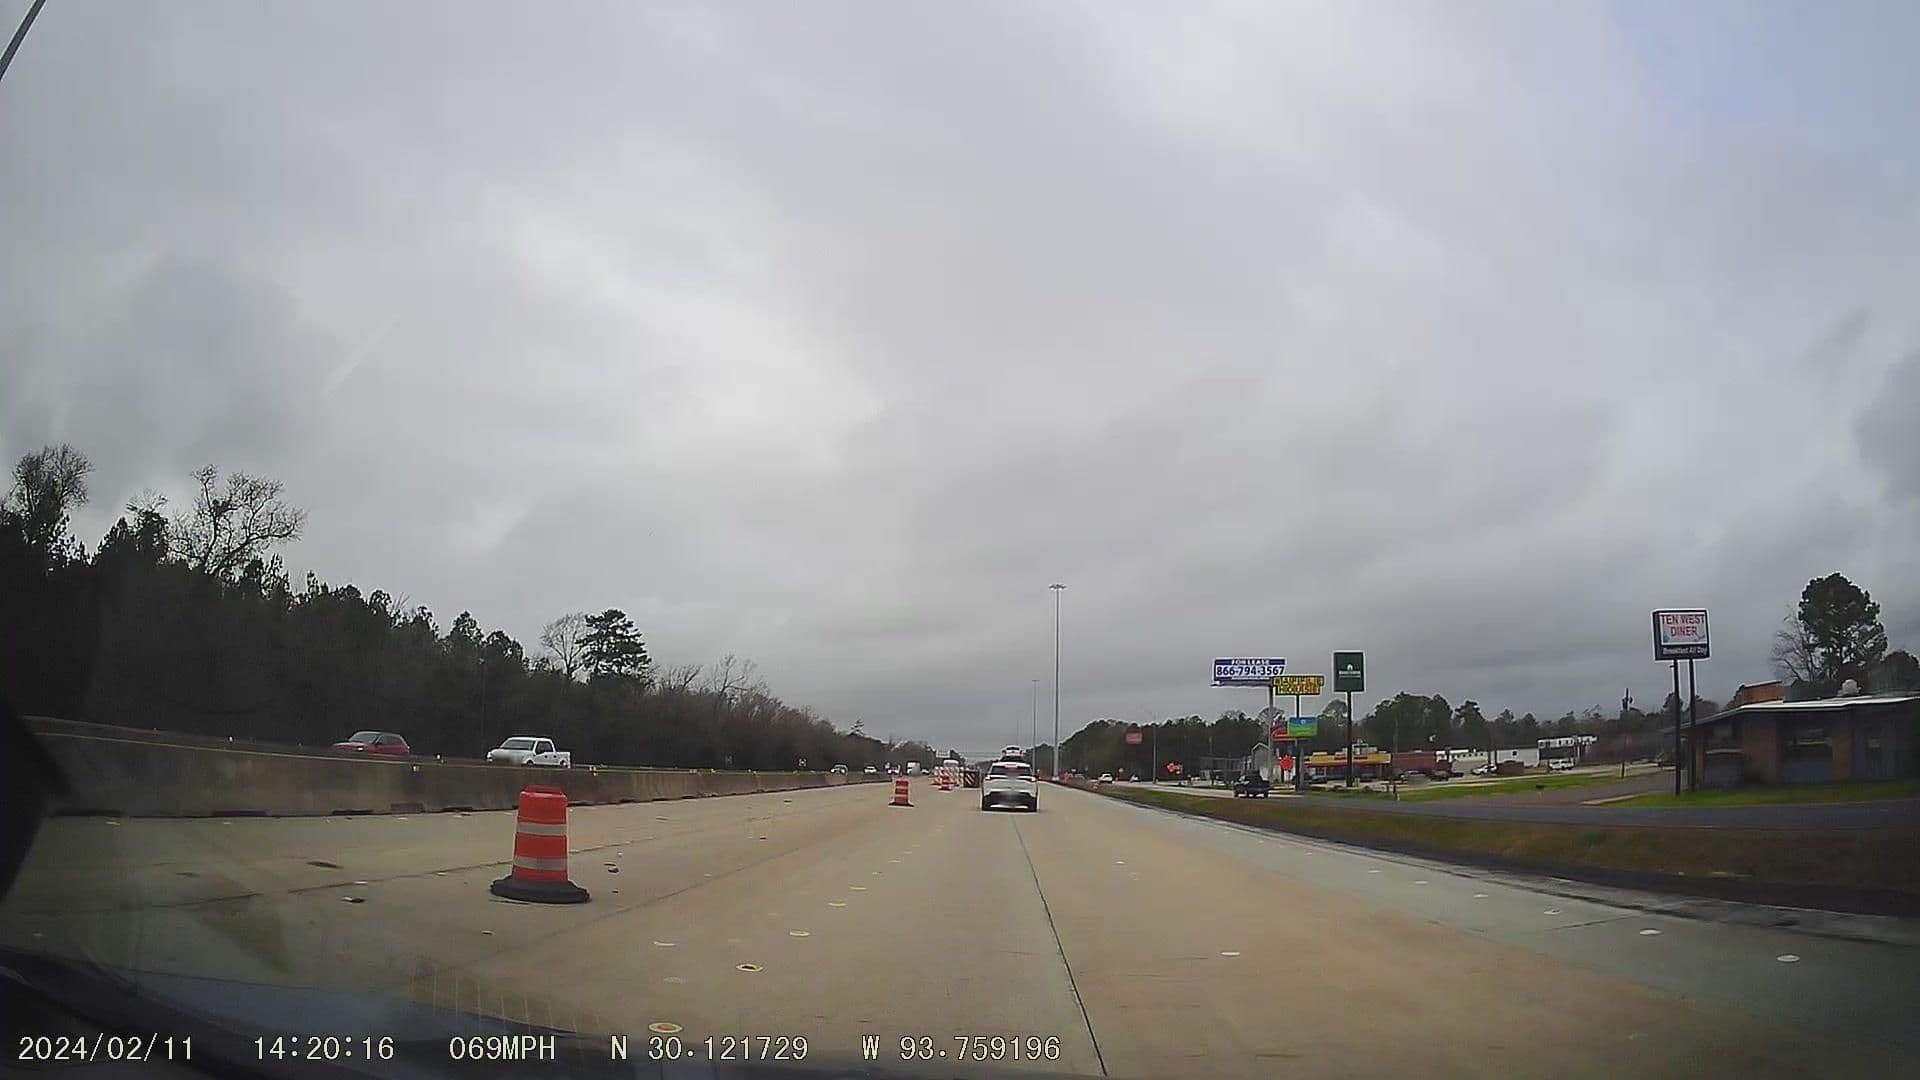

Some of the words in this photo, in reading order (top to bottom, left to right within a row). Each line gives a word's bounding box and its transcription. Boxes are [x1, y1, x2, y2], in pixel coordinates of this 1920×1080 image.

[1661, 615, 1678, 624] TEN
[1680, 614, 1705, 624] WEST
[1670, 626, 1698, 636] DINER
[1216, 666, 1285, 676] 866-794-3567
